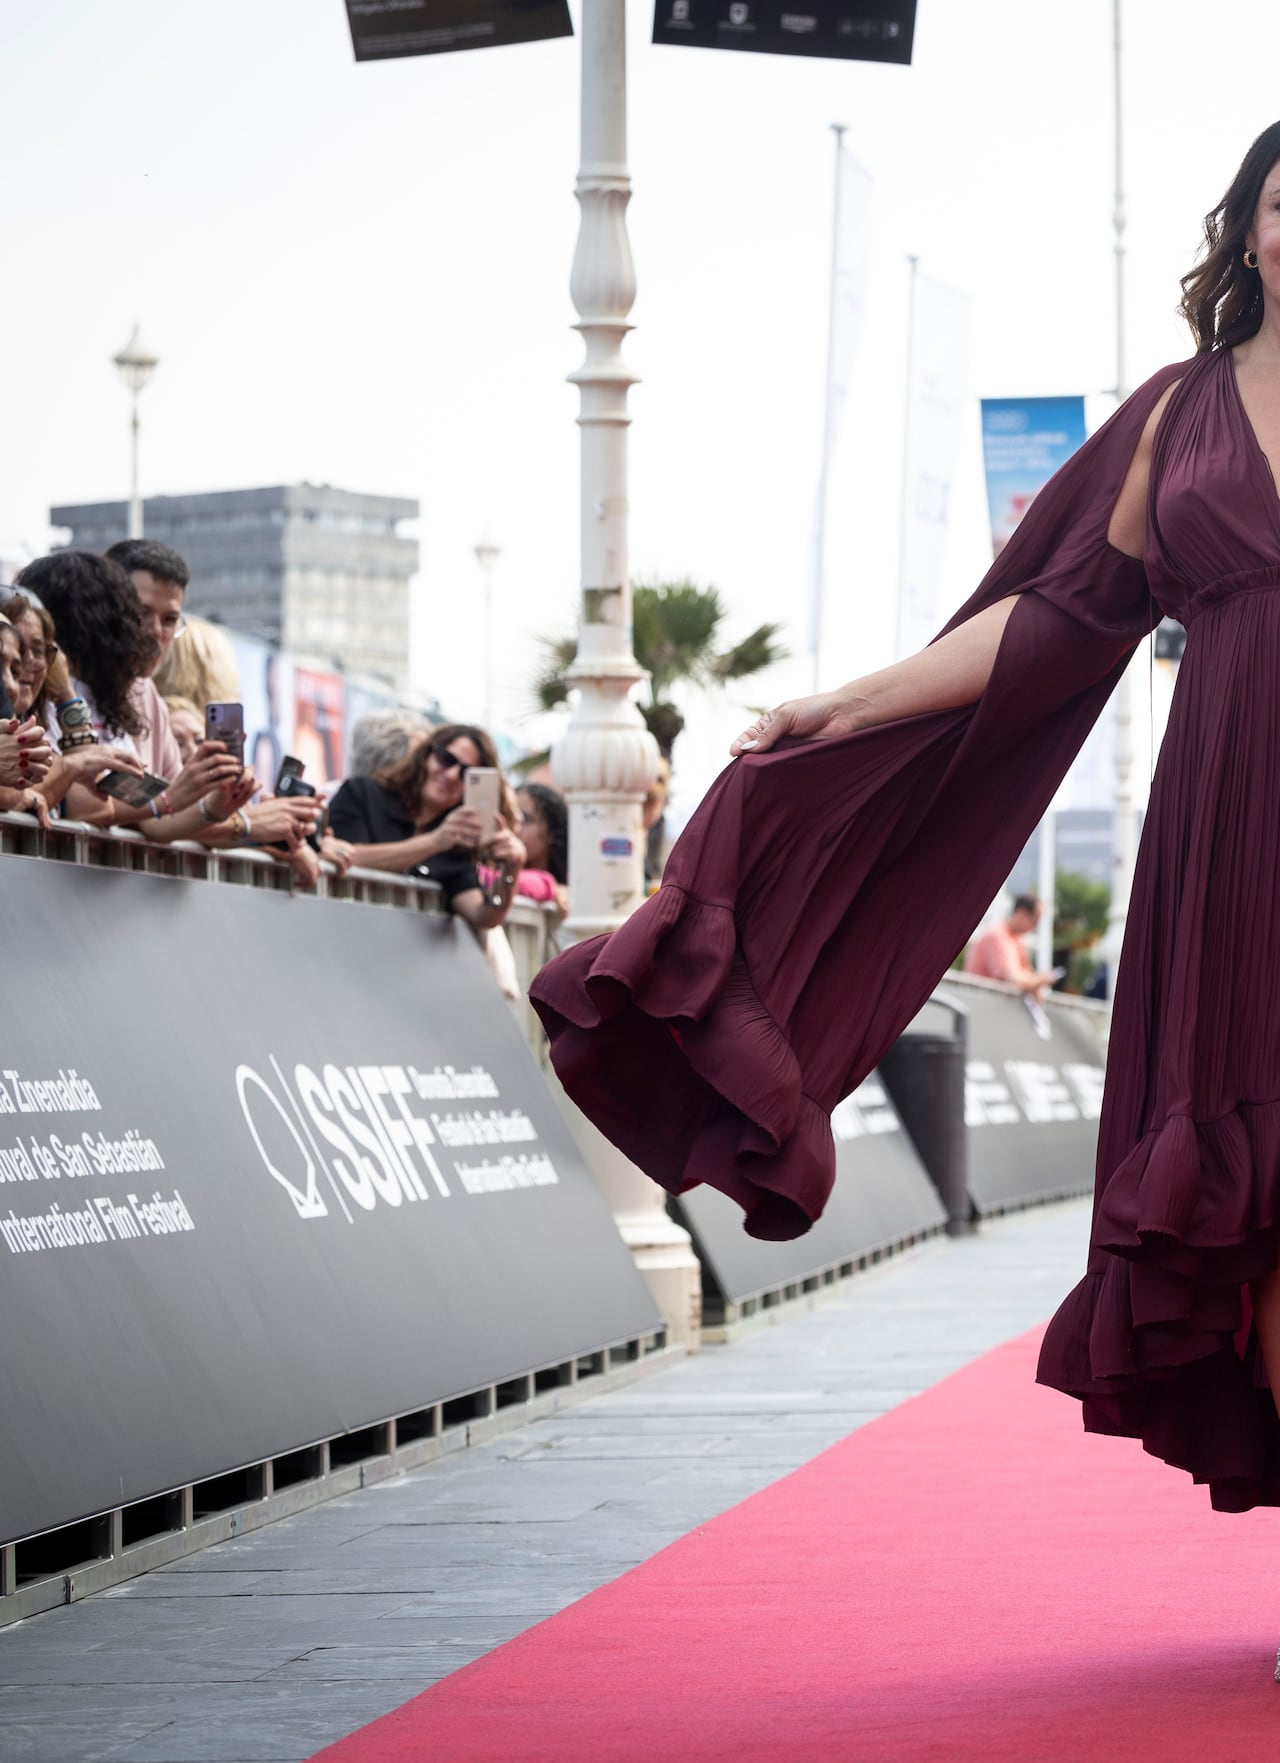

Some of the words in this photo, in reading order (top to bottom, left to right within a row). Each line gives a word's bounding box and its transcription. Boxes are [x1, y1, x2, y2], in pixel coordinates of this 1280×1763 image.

[2, 1069, 103, 1113] Zinemaldia
[30, 1135, 61, 1179] de
[49, 1133, 95, 1178] San
[81, 1129, 166, 1175] Sebastián
[294, 1063, 451, 1211] SSIFF
[0, 1199, 108, 1253] International
[93, 1197, 142, 1241] Film
[126, 1189, 196, 1236] Festival
